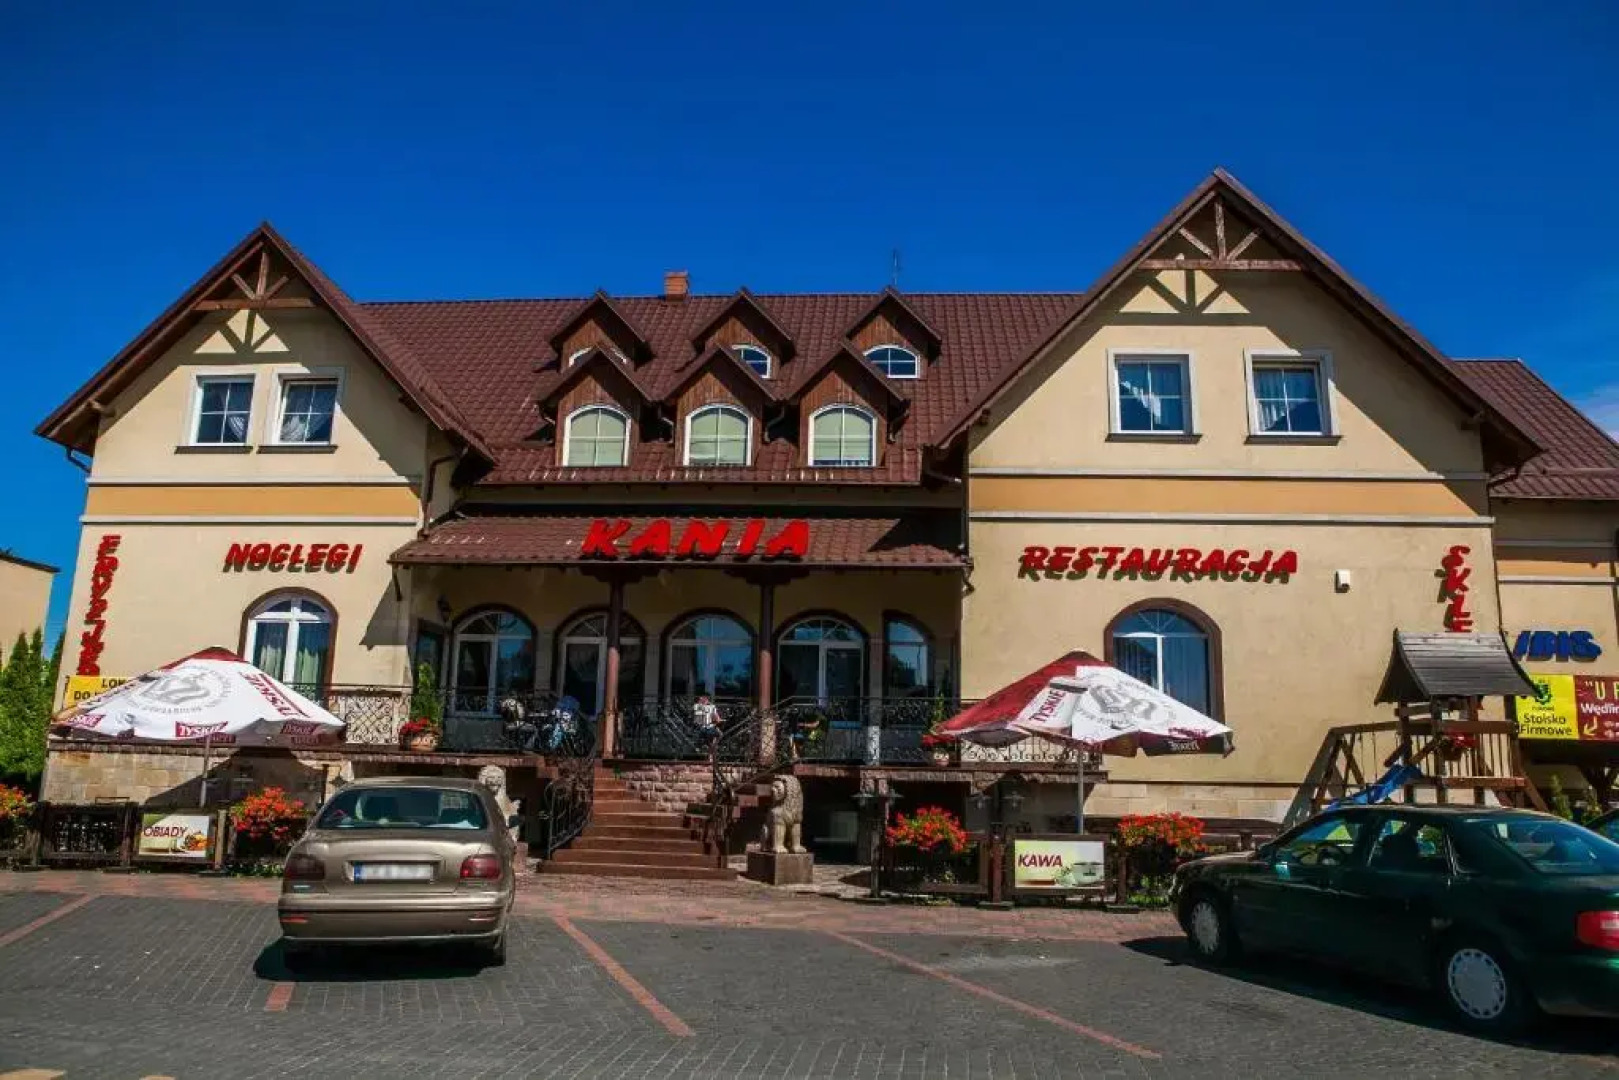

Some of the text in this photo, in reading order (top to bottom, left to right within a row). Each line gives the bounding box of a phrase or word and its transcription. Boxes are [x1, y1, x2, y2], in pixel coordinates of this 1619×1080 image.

[581, 519, 811, 556] KANIA
[224, 543, 363, 573] NOCLEGI
[1022, 546, 1299, 579] RESTAURACJA
[1514, 630, 1603, 661] IBIS
[73, 690, 91, 700] DO
[1028, 688, 1066, 723] TYSKIE
[1523, 713, 1566, 724] Stoisko
[1520, 724, 1573, 736] Firmowe
[143, 826, 188, 838] OBIADY
[1018, 854, 1063, 868] KAWA
